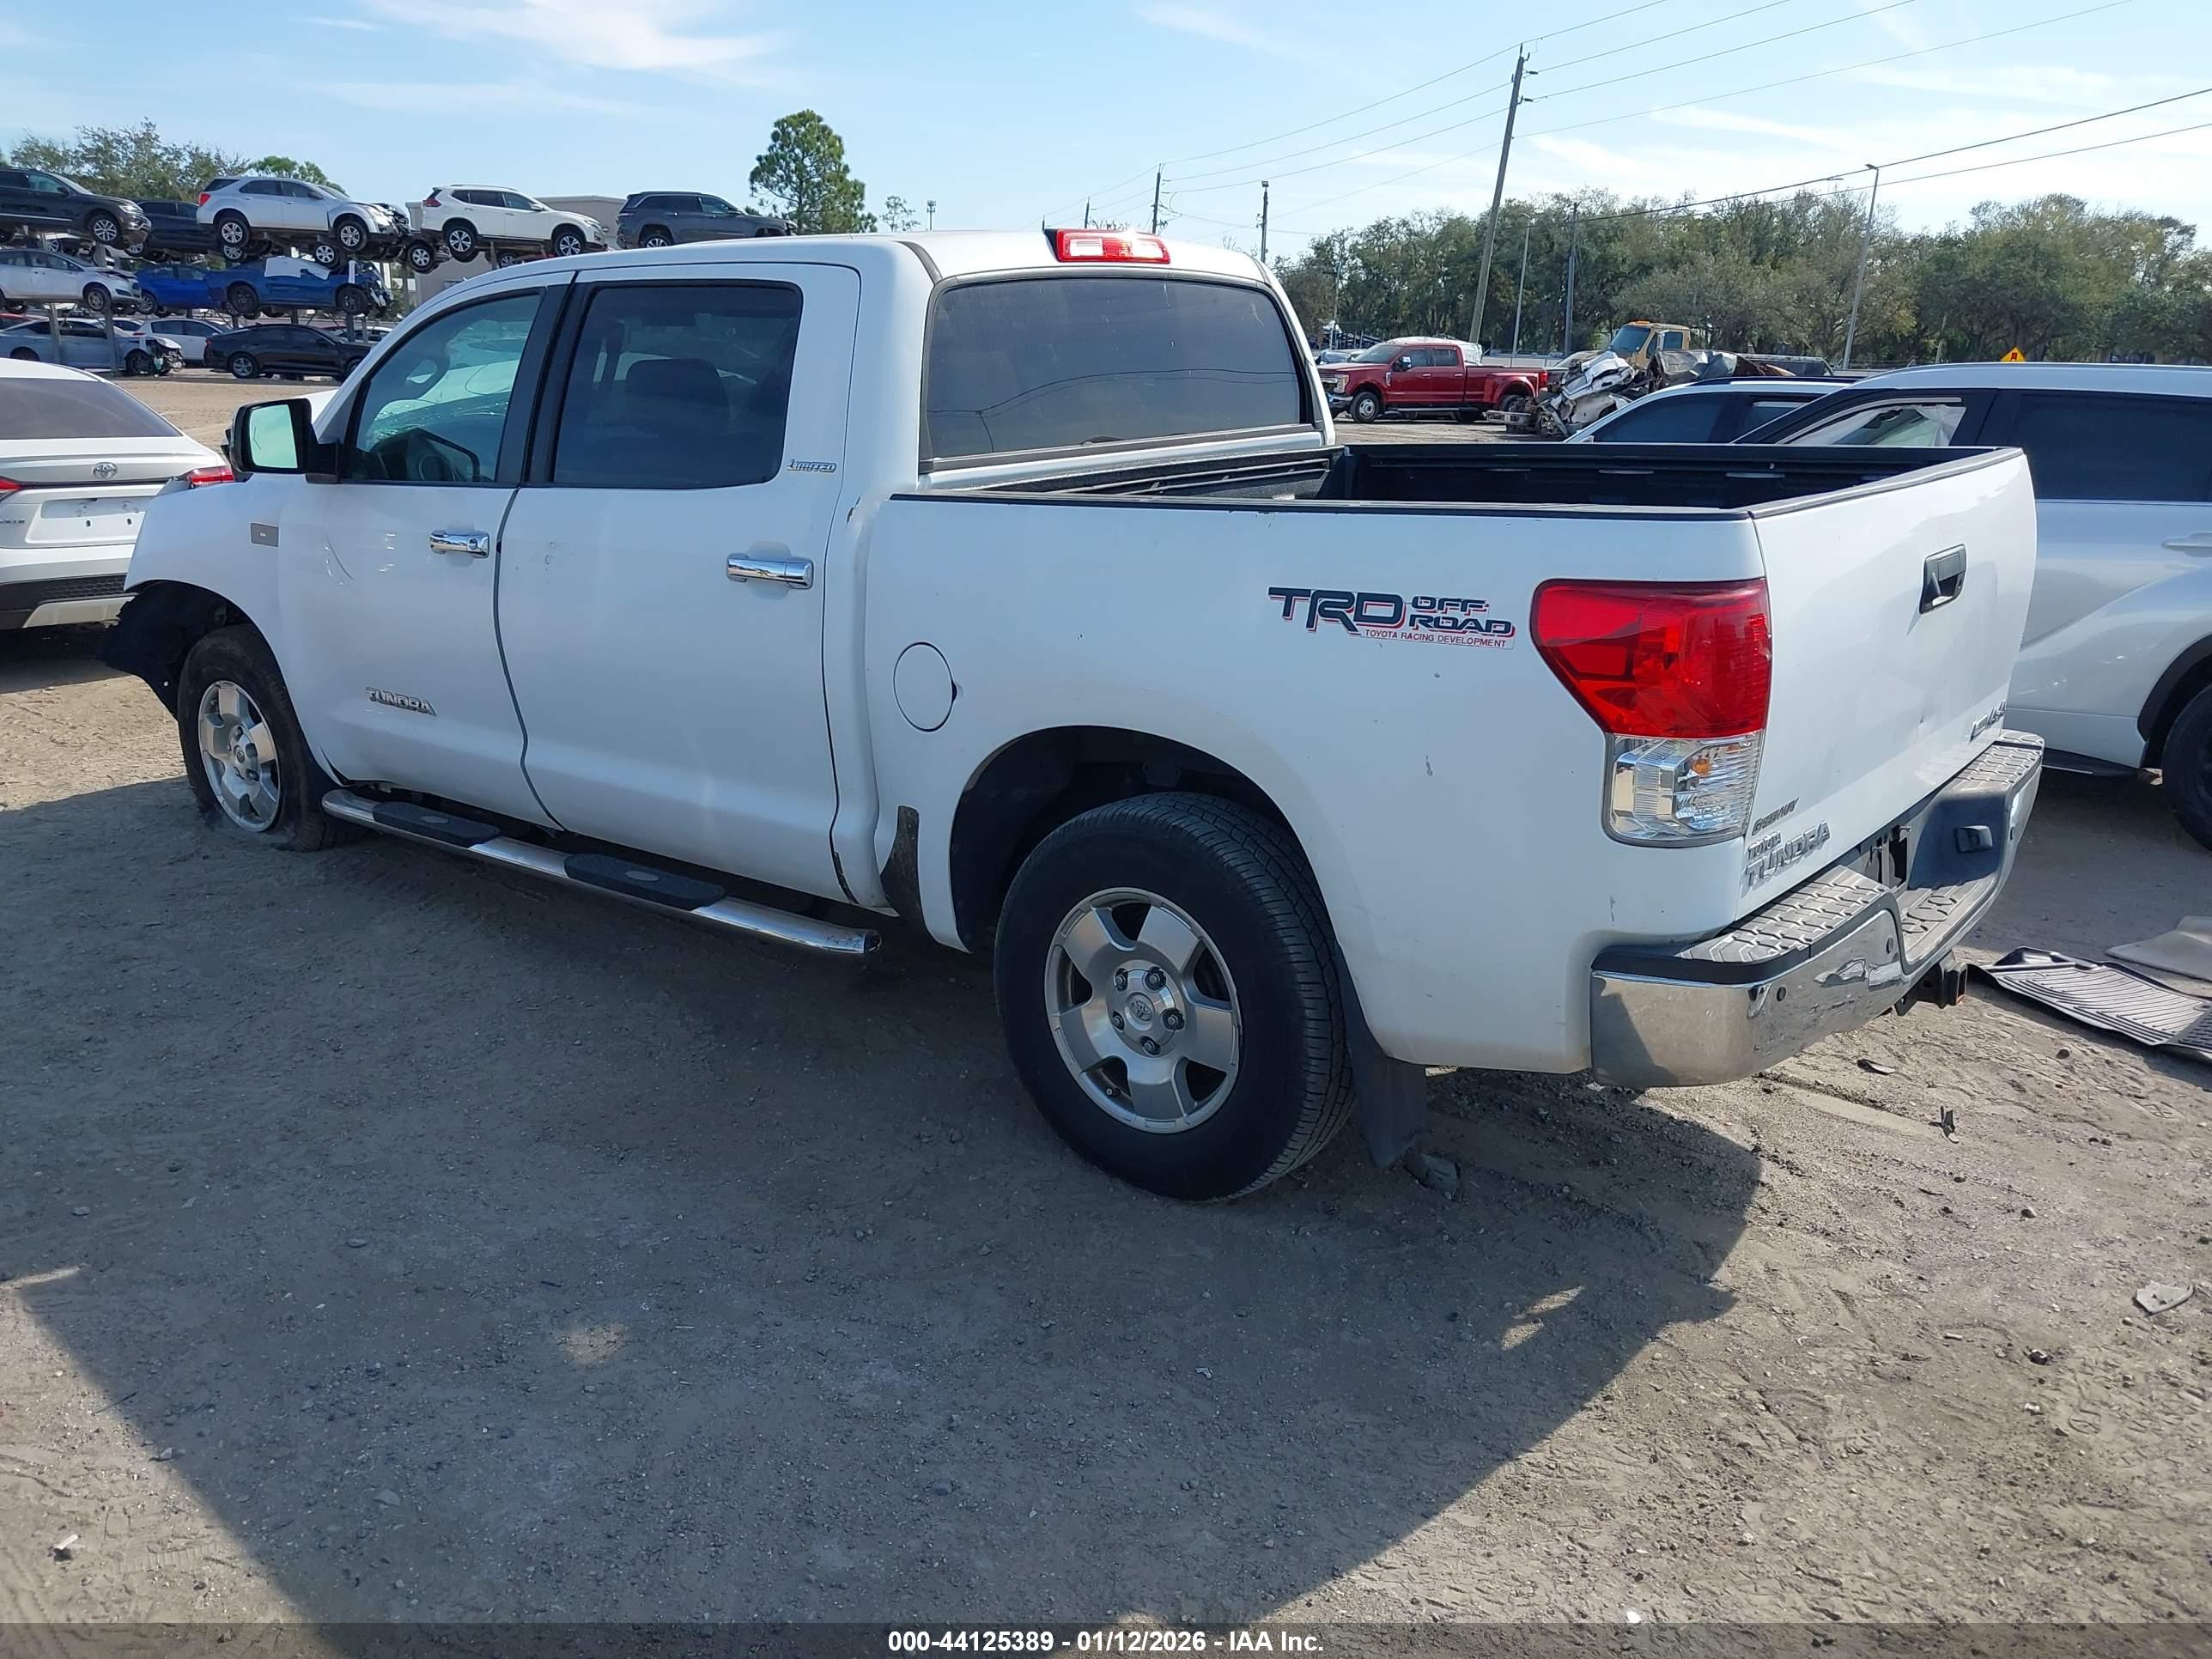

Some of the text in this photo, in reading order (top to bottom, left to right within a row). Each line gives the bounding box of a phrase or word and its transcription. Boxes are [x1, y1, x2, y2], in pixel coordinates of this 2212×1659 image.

[787, 459, 837, 473] LIMITED
[1268, 586, 1406, 634] TRD
[1411, 595, 1489, 616] OFF
[1364, 629, 1506, 647] TOYOTA RACING DEVELOPMENT
[1408, 614, 1516, 638] ROAD
[365, 687, 437, 716] TUNDRA
[1745, 820, 1830, 887] TUNDRA
[1748, 831, 1782, 860] TOYOTA
